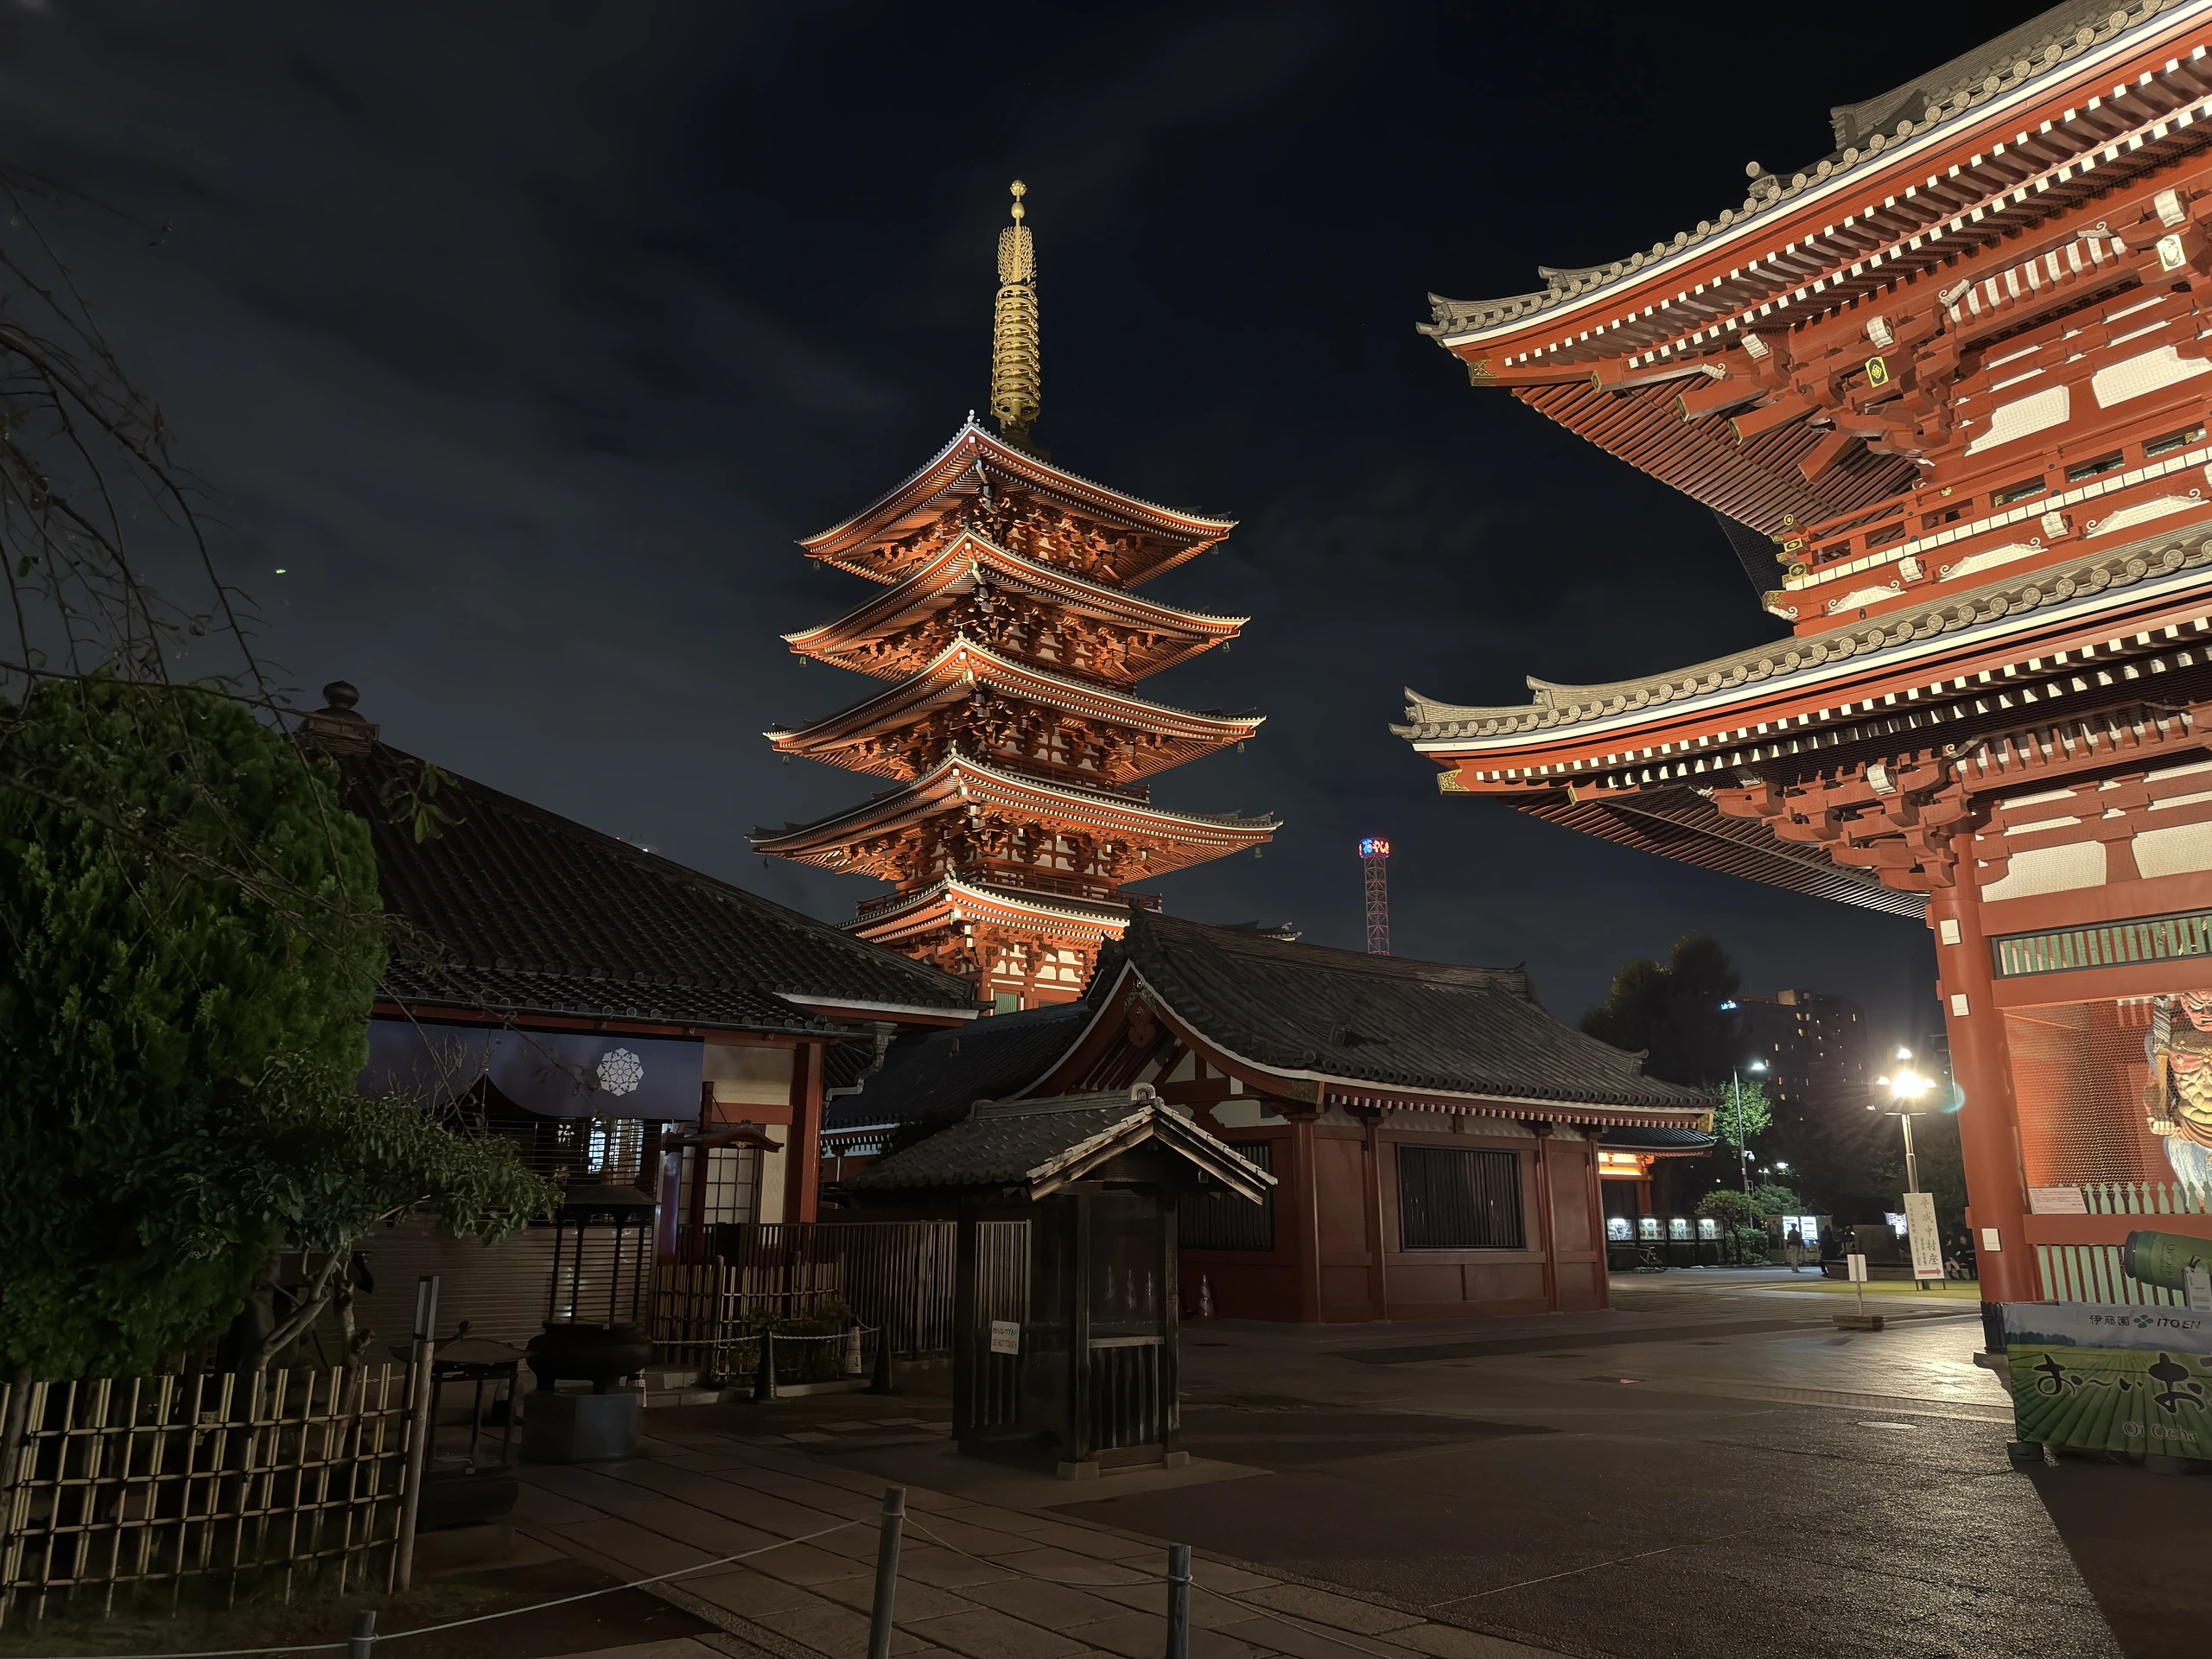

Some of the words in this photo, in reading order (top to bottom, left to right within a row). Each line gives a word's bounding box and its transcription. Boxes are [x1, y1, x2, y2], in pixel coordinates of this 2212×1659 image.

[1920, 1197, 1939, 1265] 平成中村座
[2089, 1314, 2130, 1326] 伊藤園
[2122, 1421, 2145, 1437] Oi
[2152, 1425, 2197, 1443] Ocha
